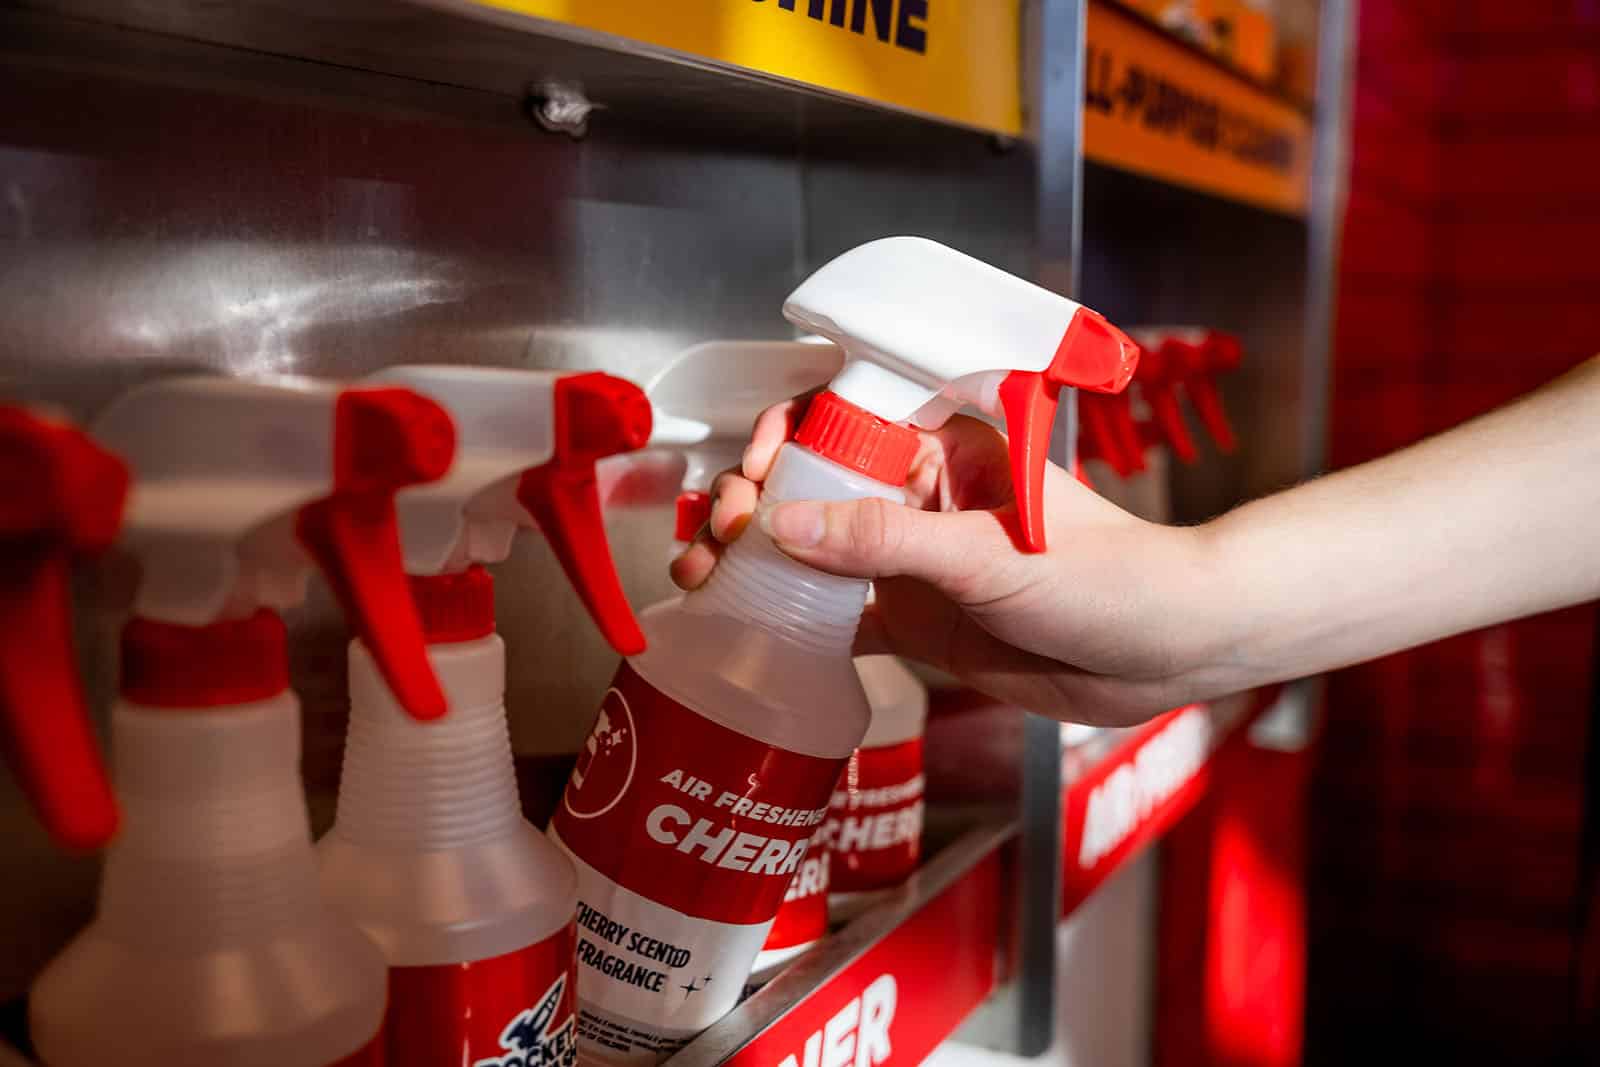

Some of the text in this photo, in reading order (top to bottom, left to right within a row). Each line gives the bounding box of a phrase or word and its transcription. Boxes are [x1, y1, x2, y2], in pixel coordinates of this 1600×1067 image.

[660, 768, 713, 801] AIR
[577, 938, 667, 992] FRAGRANCE
[479, 1020, 574, 1067] CKET
